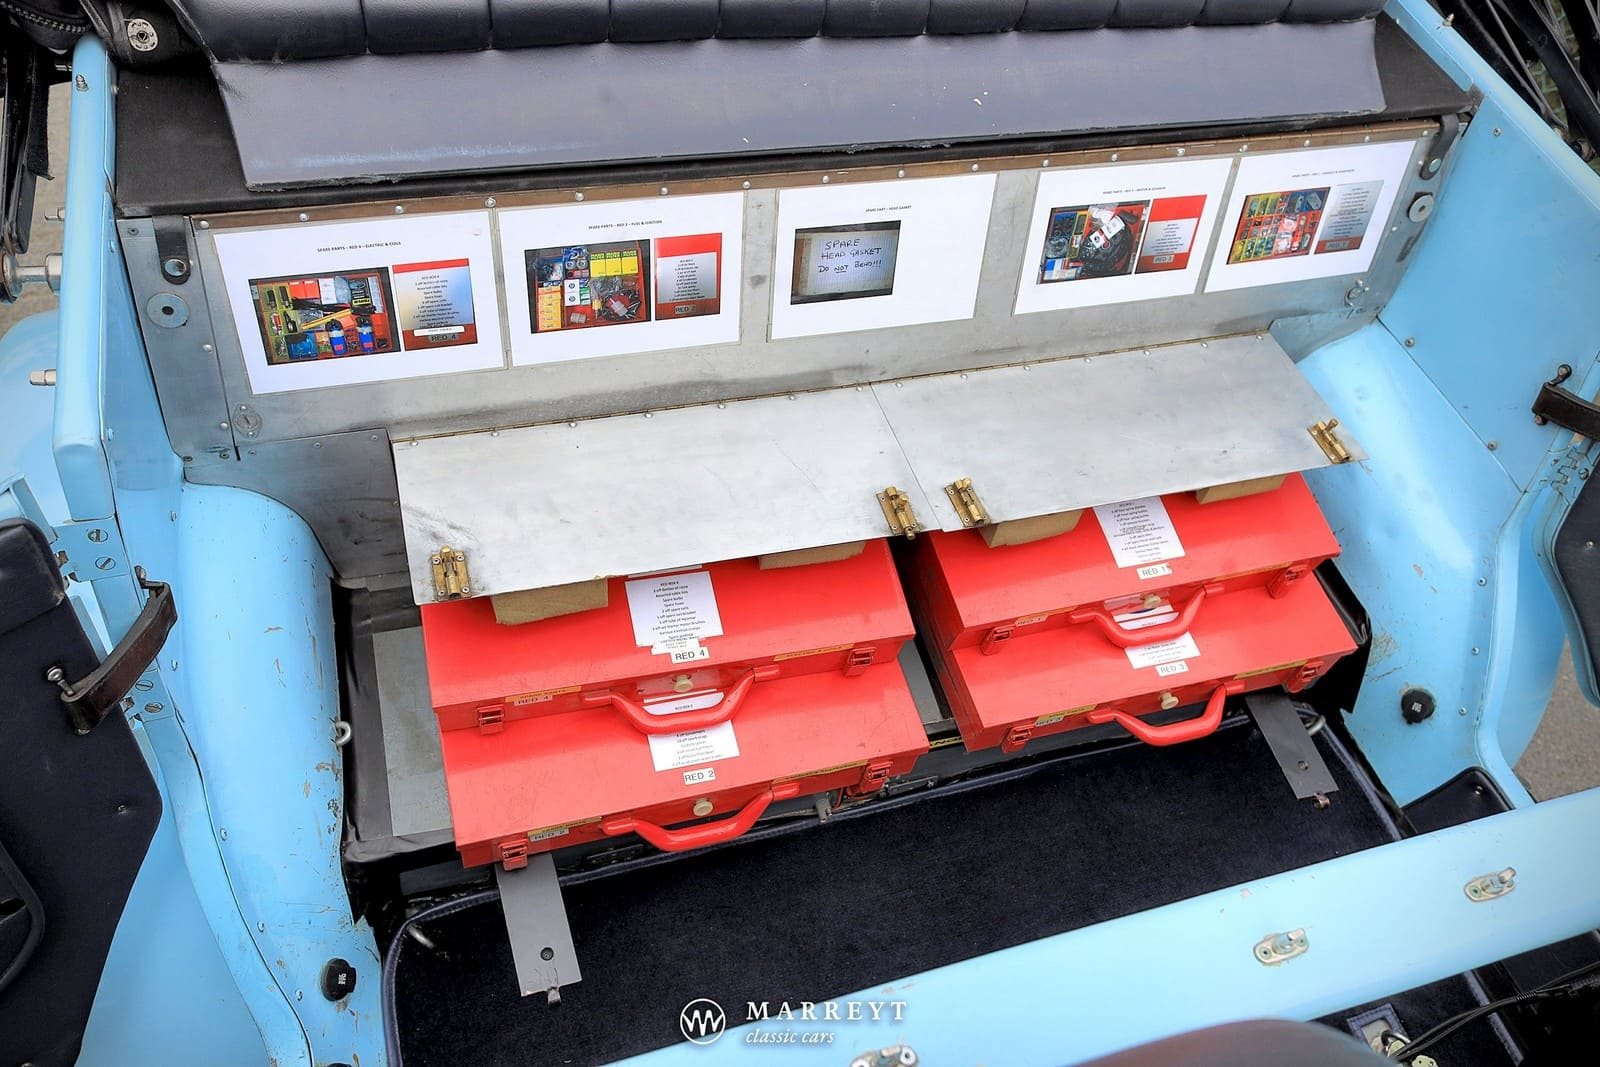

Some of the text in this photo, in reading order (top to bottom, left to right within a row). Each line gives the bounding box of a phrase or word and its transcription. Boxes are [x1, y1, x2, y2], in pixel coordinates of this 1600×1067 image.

[825, 238, 861, 250] SPARE
[821, 247, 882, 260] HEAD GASKET
[834, 264, 849, 272] NOT
[1142, 568, 1158, 576] RED
[675, 651, 695, 660] RED
[1160, 665, 1177, 673] RED
[684, 772, 704, 782] RED
